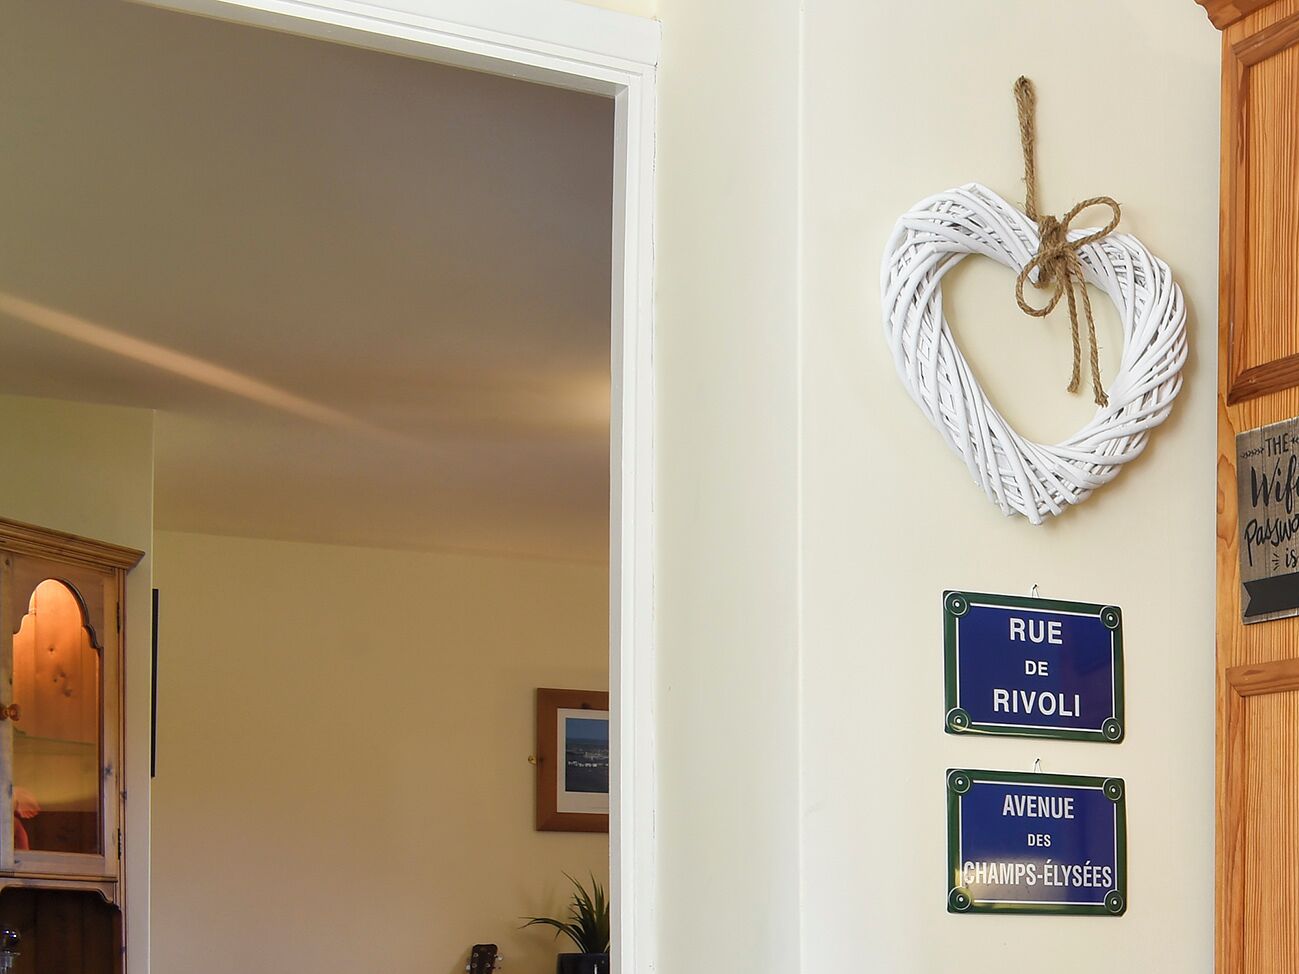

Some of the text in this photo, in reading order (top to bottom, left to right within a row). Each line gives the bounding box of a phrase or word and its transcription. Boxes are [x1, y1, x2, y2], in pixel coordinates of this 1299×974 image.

[1265, 433, 1290, 456] THE
[1284, 547, 1299, 569] is
[1009, 617, 1063, 645] RUE
[1025, 660, 1049, 677] DE
[993, 688, 1081, 718] RIVOLI
[1002, 794, 1075, 820] AVENUE
[1027, 833, 1052, 848] DES
[963, 858, 1113, 888] CHAMPS-ÉLYSÉES
